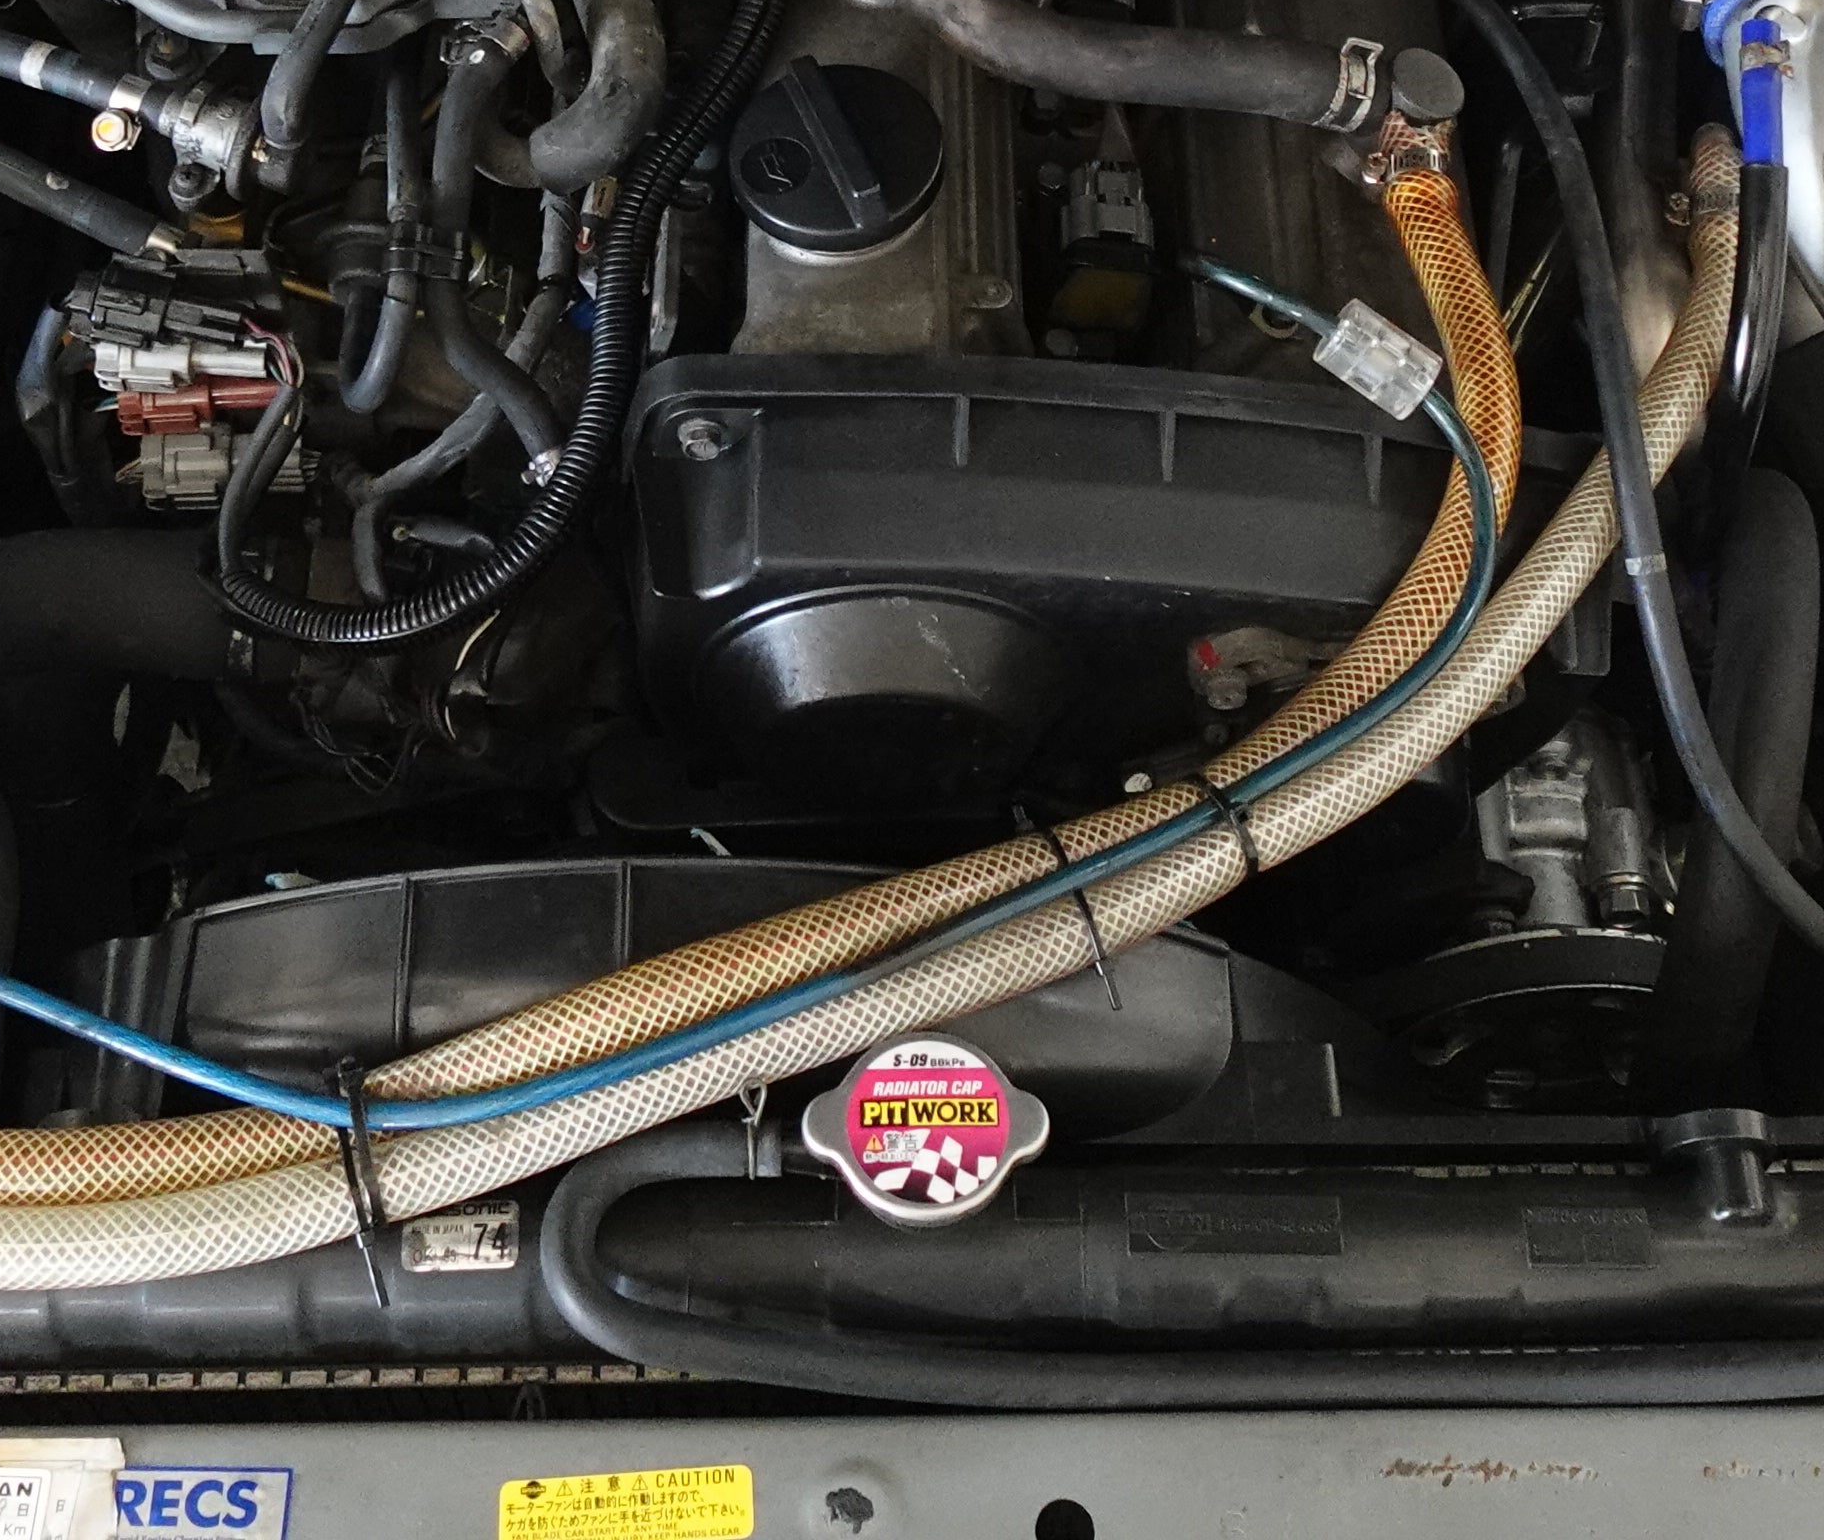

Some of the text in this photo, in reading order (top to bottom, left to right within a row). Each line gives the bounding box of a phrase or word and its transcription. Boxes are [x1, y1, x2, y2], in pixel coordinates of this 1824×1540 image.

[893, 1054, 928, 1067] S-09
[873, 1080, 983, 1096] RADIATOR CAP
[863, 1101, 995, 1126] PITWORK
[474, 1223, 508, 1260] 74
[656, 1468, 735, 1488] CAUTION
[17, 1503, 29, 1517] 日
[116, 1479, 259, 1528] RECS
[3, 1522, 27, 1537] Km
[565, 1529, 585, 1538] CAN
[588, 1527, 616, 1537] START
[620, 1526, 631, 1535] AT
[634, 1524, 654, 1534] ANY
[657, 1522, 678, 1532] TIME
[677, 1529, 707, 1539] HANDS
